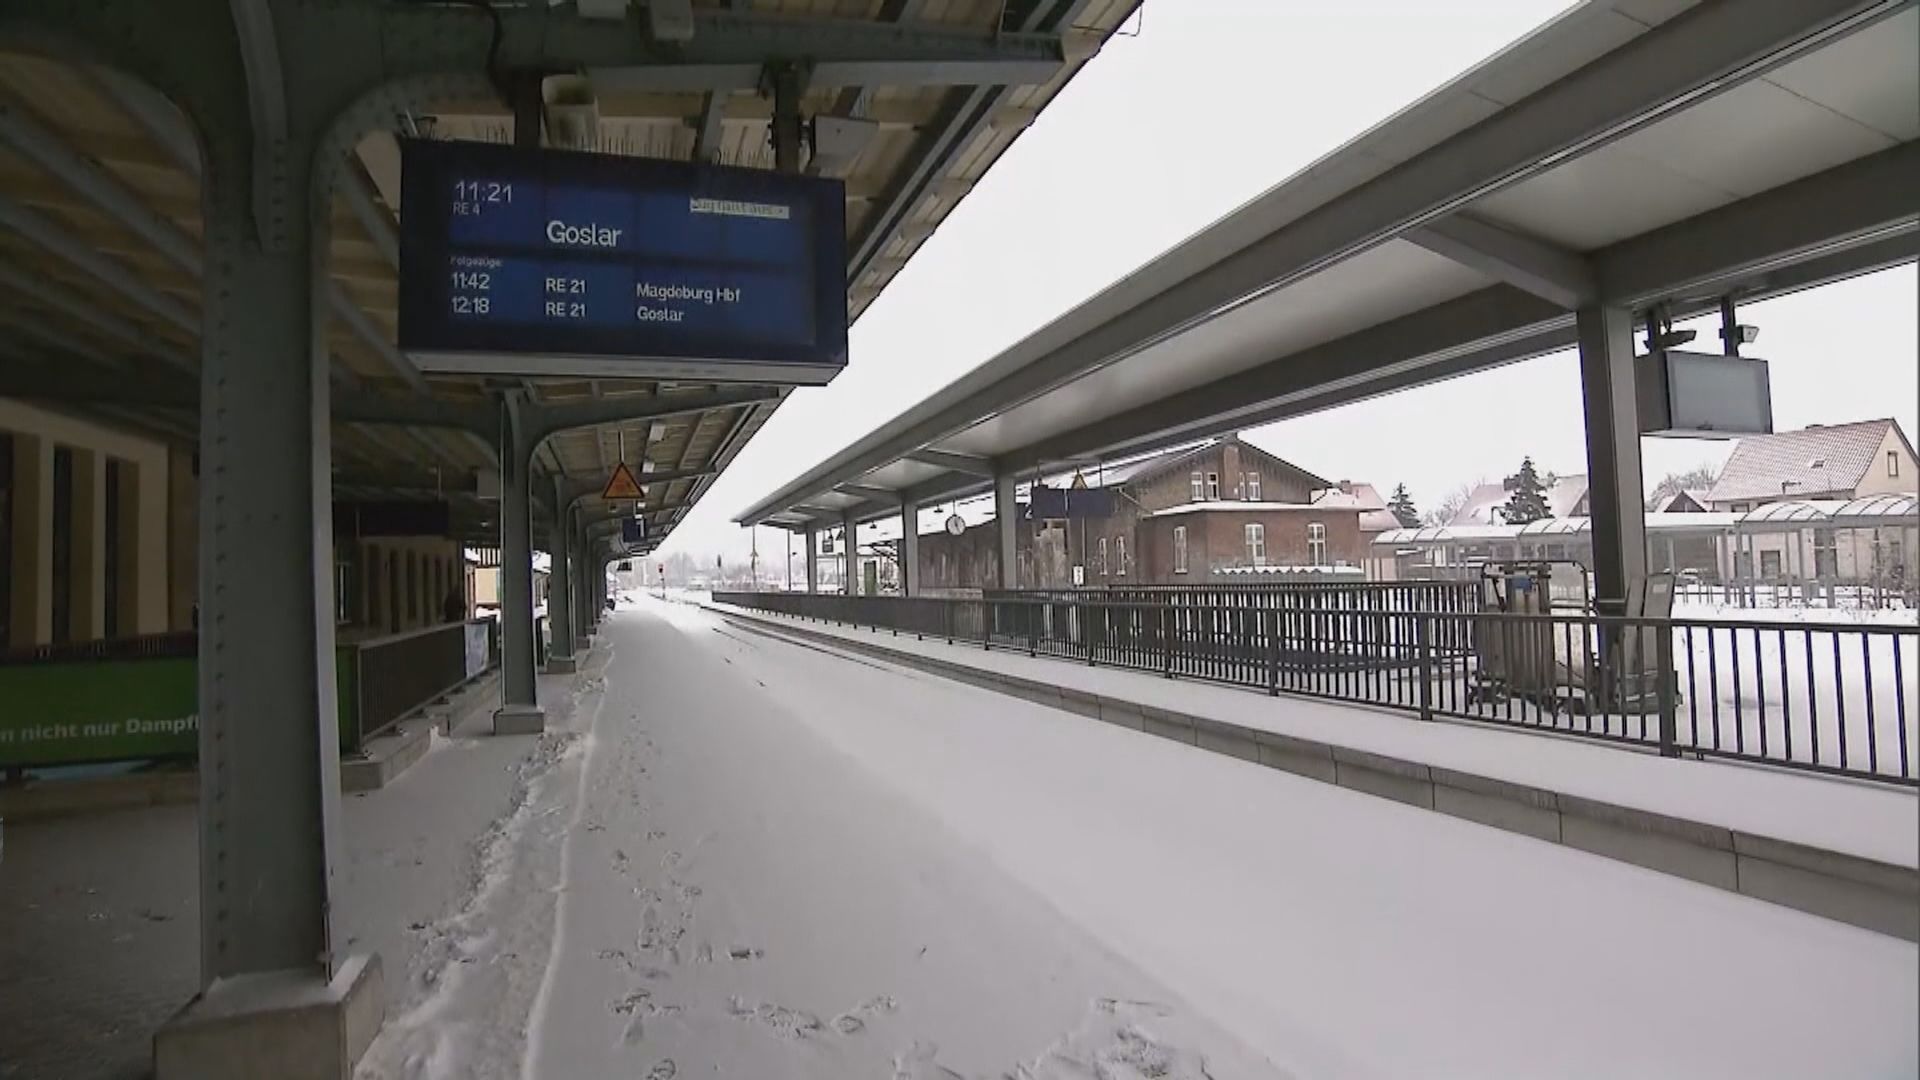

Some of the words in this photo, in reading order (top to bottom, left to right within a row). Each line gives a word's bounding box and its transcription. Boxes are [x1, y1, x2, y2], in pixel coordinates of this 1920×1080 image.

[455, 180, 513, 203] 11:21
[452, 202, 469, 215] RE
[472, 203, 480, 216] 4
[546, 220, 623, 247] Goslar
[452, 272, 490, 289] 11:42
[546, 278, 566, 293] RE
[570, 279, 586, 293] 21
[636, 282, 714, 304] Magdeburg
[716, 288, 741, 303] Hbf
[451, 296, 490, 314] 12:18
[546, 302, 566, 316] RE
[570, 303, 586, 317] 21
[636, 305, 685, 322] Goslar
[21, 722, 78, 742] nicht
[83, 722, 121, 737] nur
